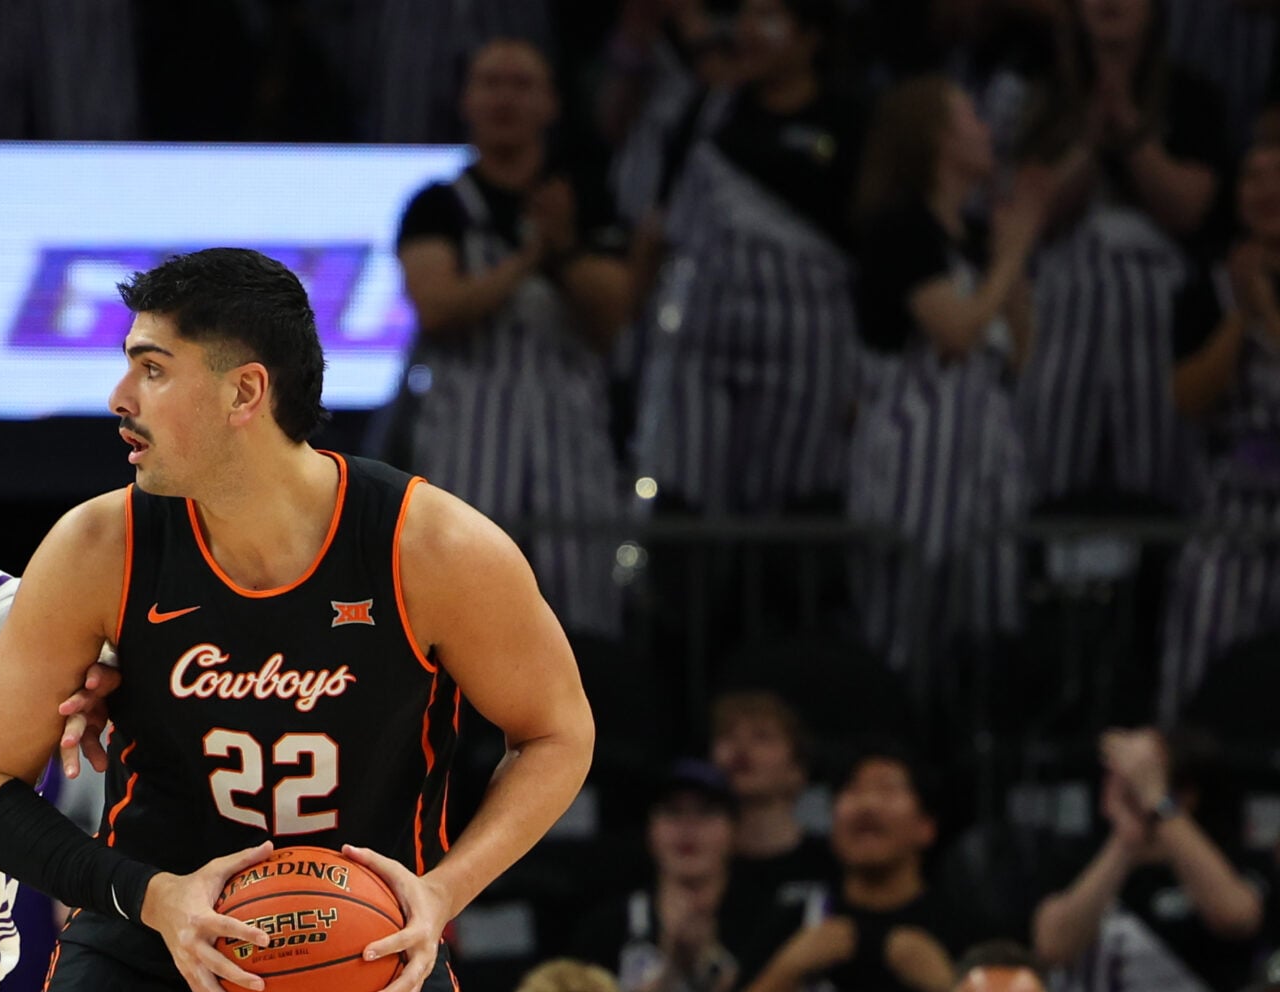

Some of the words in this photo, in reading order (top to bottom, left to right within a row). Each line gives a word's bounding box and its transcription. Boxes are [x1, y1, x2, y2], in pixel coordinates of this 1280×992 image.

[10, 244, 417, 350] GU
[333, 602, 373, 625] XII
[169, 642, 357, 712] Cowboys
[202, 726, 340, 837] 22
[225, 908, 338, 945] GACY
[258, 932, 328, 951] 000
